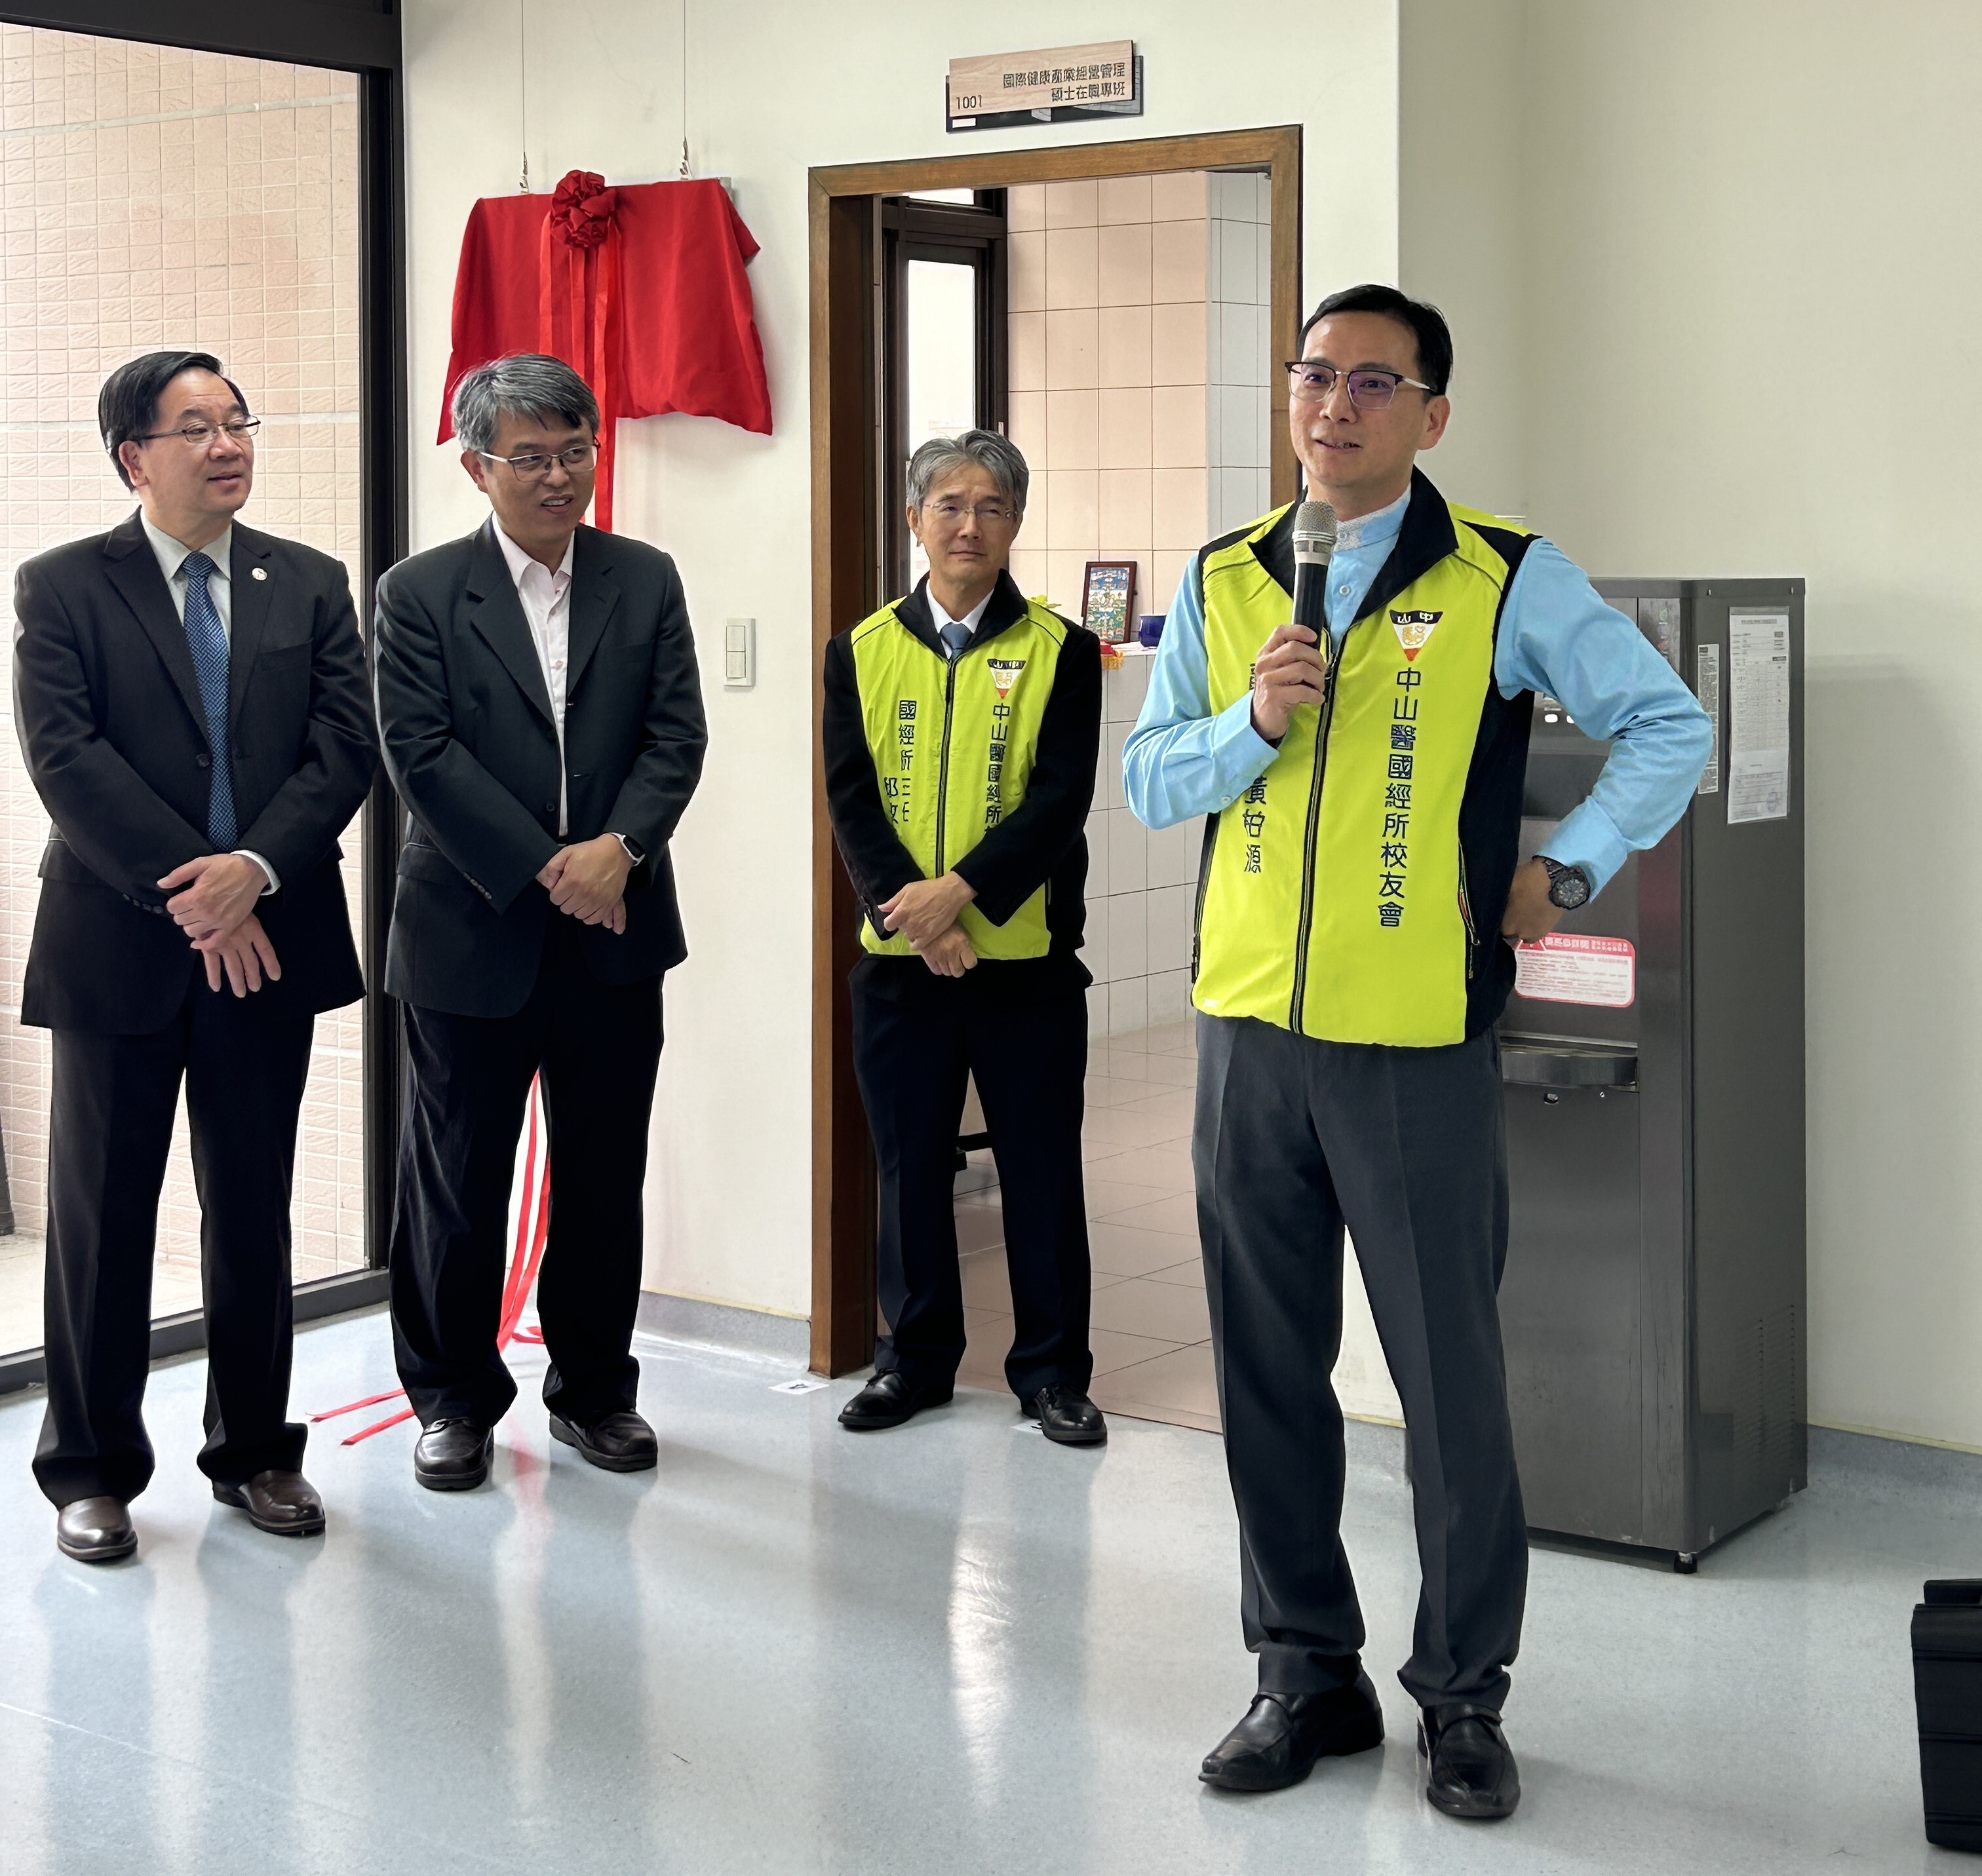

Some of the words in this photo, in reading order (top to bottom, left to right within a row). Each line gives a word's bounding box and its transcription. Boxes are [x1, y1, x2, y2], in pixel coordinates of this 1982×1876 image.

[956, 94, 982, 110] 1001
[1051, 81, 1125, 102] 碩士在職專班
[984, 702, 1010, 833] 中山醫國經所
[1378, 667, 1422, 927] 中山醫國經所校友會
